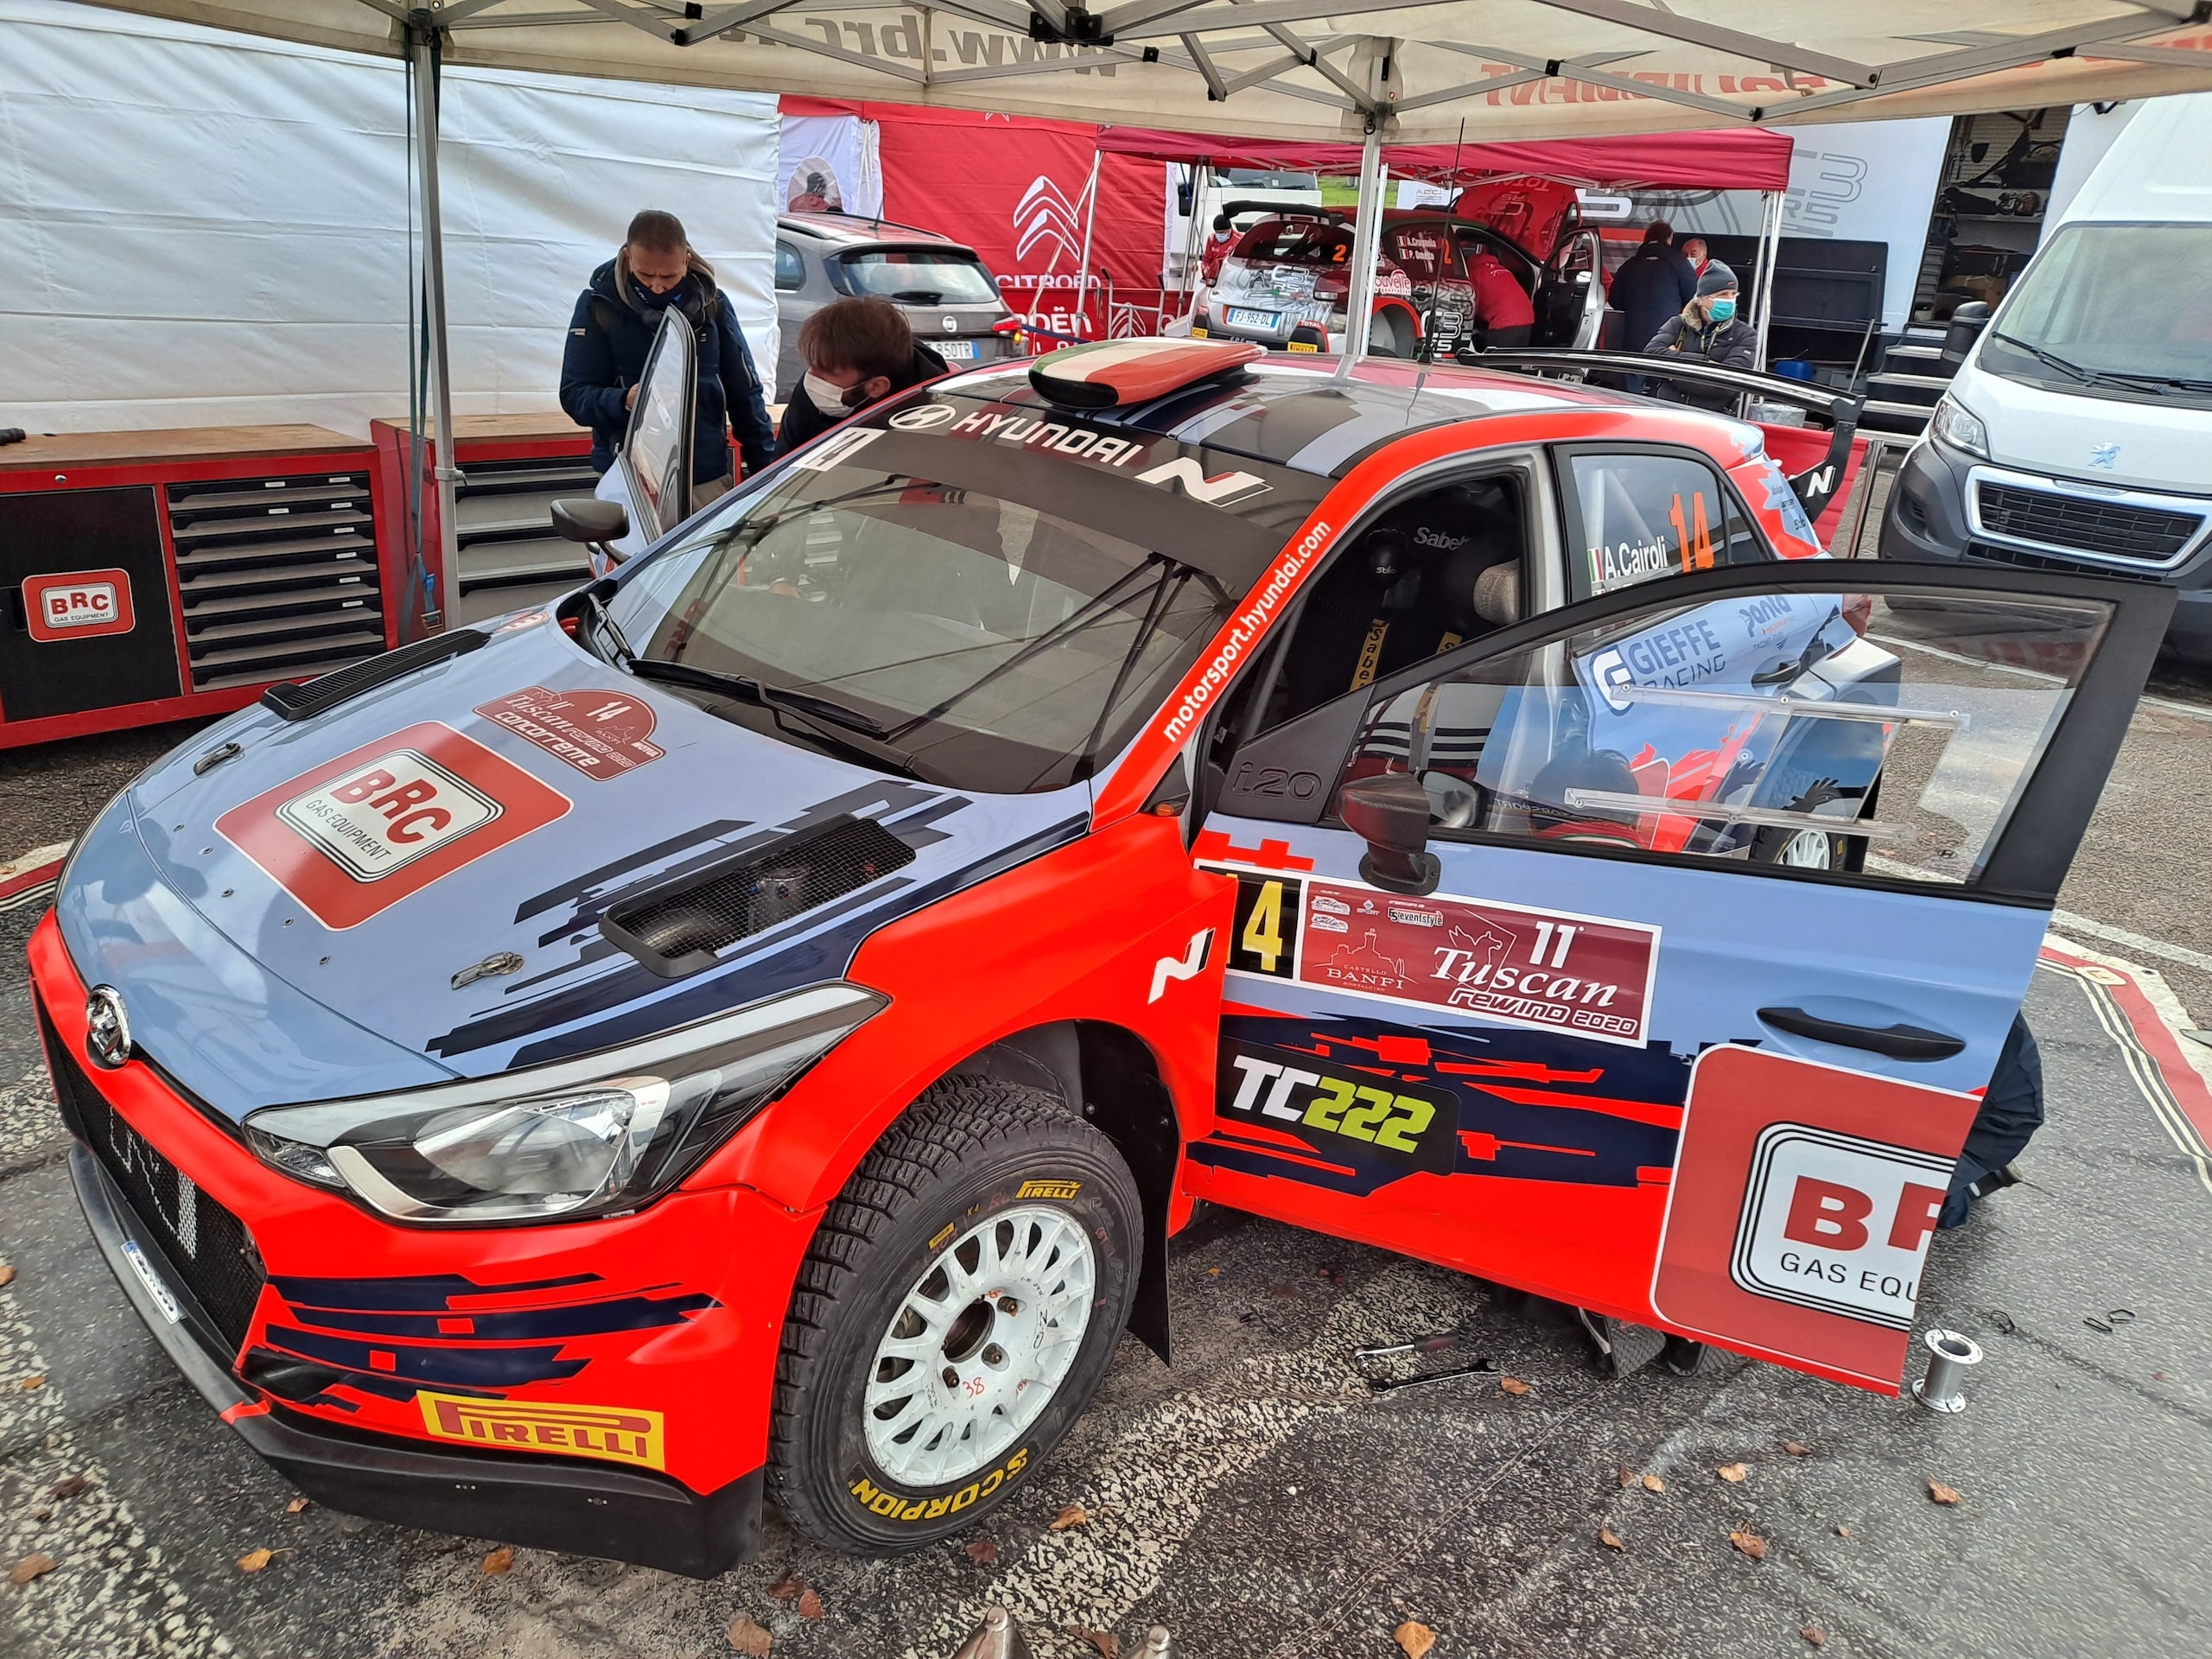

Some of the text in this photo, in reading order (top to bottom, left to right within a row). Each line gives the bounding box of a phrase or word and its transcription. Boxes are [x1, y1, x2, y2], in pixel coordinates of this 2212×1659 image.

[1332, 245, 1347, 262] 2
[1373, 275, 1411, 290] ouvelle
[1014, 306, 1093, 334] ROËN
[1300, 320, 1322, 328] TOTAL
[950, 411, 1144, 467] HYUNDAI
[1669, 492, 1715, 573] 14
[1604, 534, 1669, 581] A.Cairoli
[50, 592, 109, 614] BRC
[71, 612, 110, 621] EQUIPMENT
[1162, 518, 1332, 744] motorsport.hyundai.com
[1628, 620, 1723, 675] GIEFFE
[1358, 628, 1383, 687] Sabe
[586, 701, 632, 722] 14
[1232, 760, 1322, 802] i20
[329, 768, 452, 844] BRC
[305, 799, 392, 861] GAS EQUIPMENT
[1226, 873, 1283, 973] 4
[1326, 967, 1404, 990] BANFI
[1344, 963, 1388, 976] CASTELLO
[1430, 946, 1618, 1007] Tuscan
[1572, 1009, 1639, 1036] 2020
[1232, 1054, 1437, 1154] TC222
[1014, 1179, 1083, 1201] PIRELLI
[1780, 1251, 1847, 1285] GAS
[433, 1399, 652, 1459] PIRELLI
[850, 1446, 1029, 1522] SCORPION
